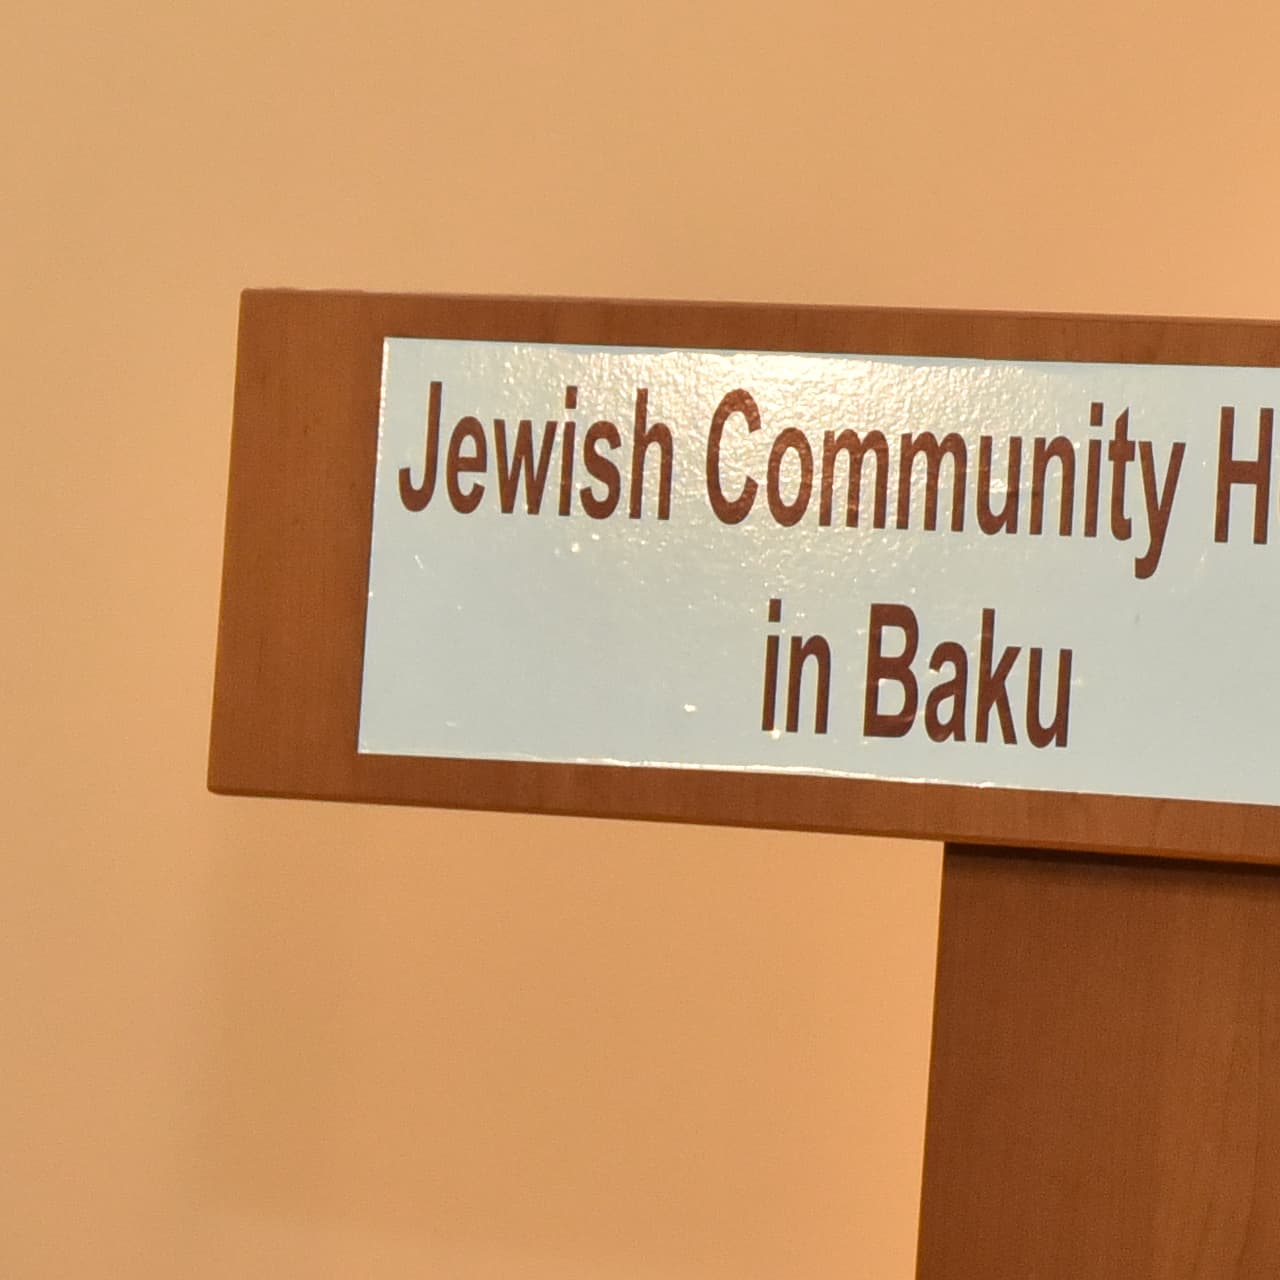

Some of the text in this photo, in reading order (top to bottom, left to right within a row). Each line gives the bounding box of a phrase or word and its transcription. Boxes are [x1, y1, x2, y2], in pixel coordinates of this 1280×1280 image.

[397, 379, 675, 522] Jewish
[704, 387, 1188, 581] Community
[760, 597, 1074, 750] in Baku
